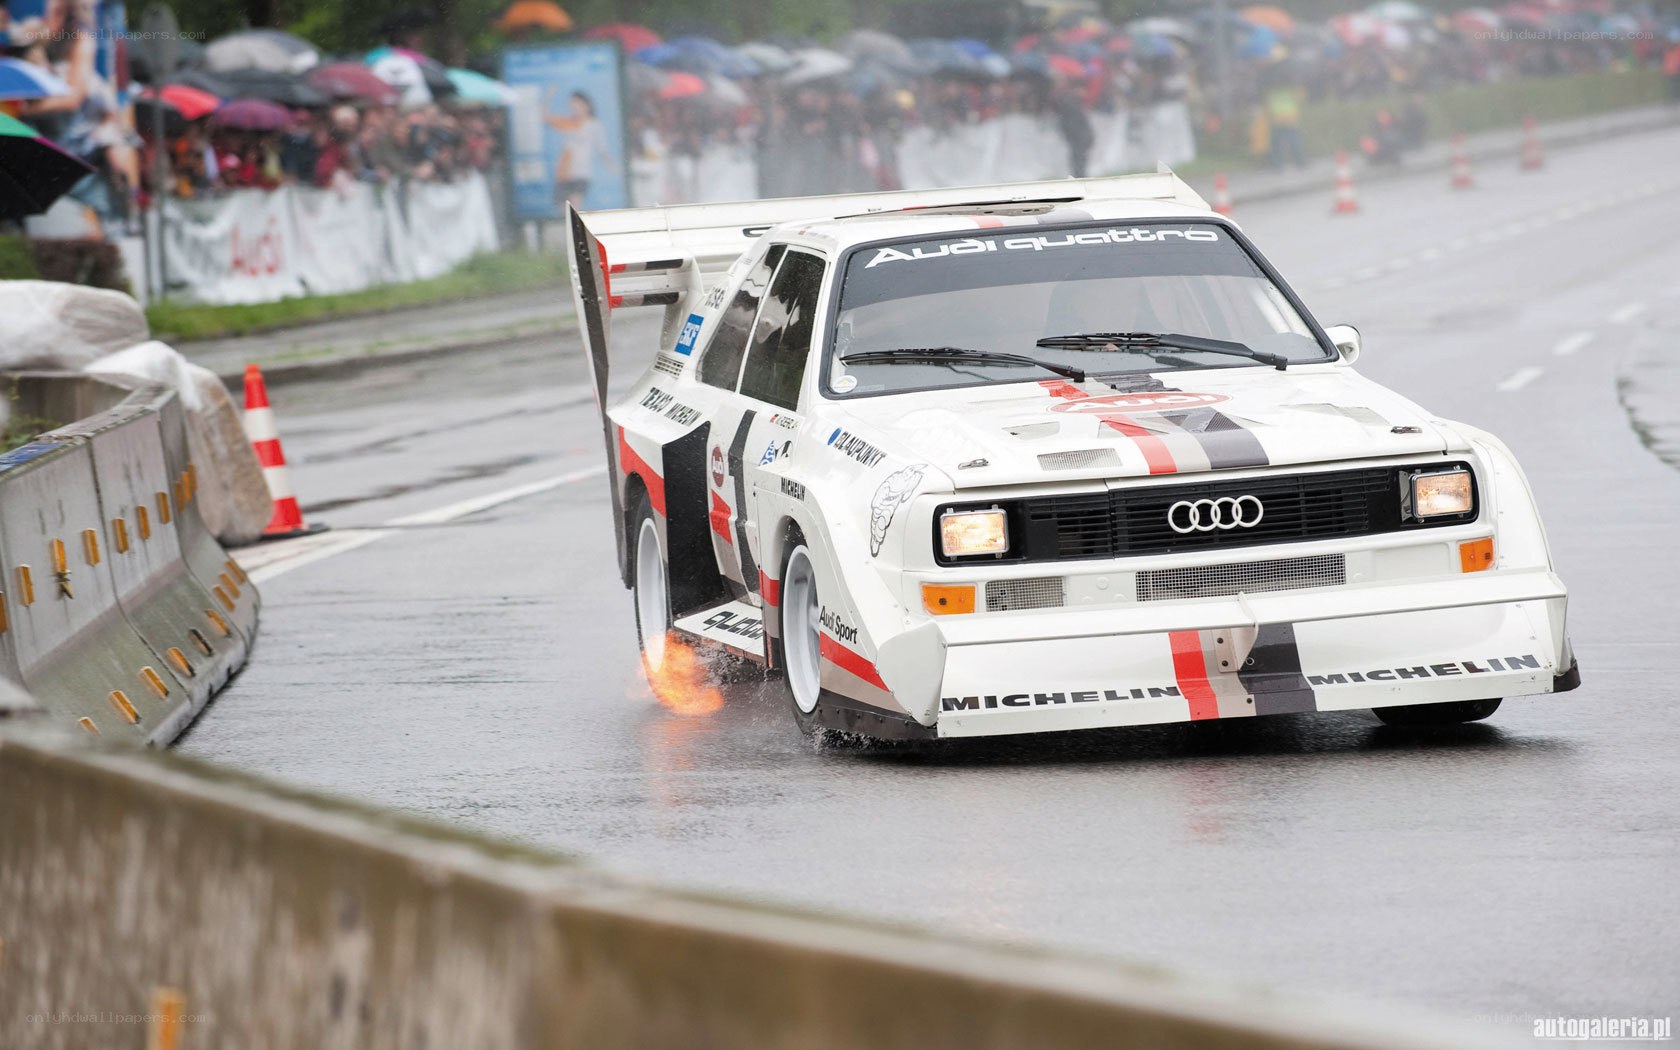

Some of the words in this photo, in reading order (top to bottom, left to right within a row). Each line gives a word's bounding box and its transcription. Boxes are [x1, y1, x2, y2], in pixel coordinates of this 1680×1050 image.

[864, 239, 997, 268] Audi
[1005, 228, 1219, 250] quattro
[834, 431, 887, 468] BLAUPUNKT
[781, 477, 806, 502] MICHELIN
[819, 605, 837, 632] Audi
[835, 616, 858, 645] Sport
[1307, 654, 1541, 686] MICHELIN
[942, 686, 1181, 711] MICHELIN
